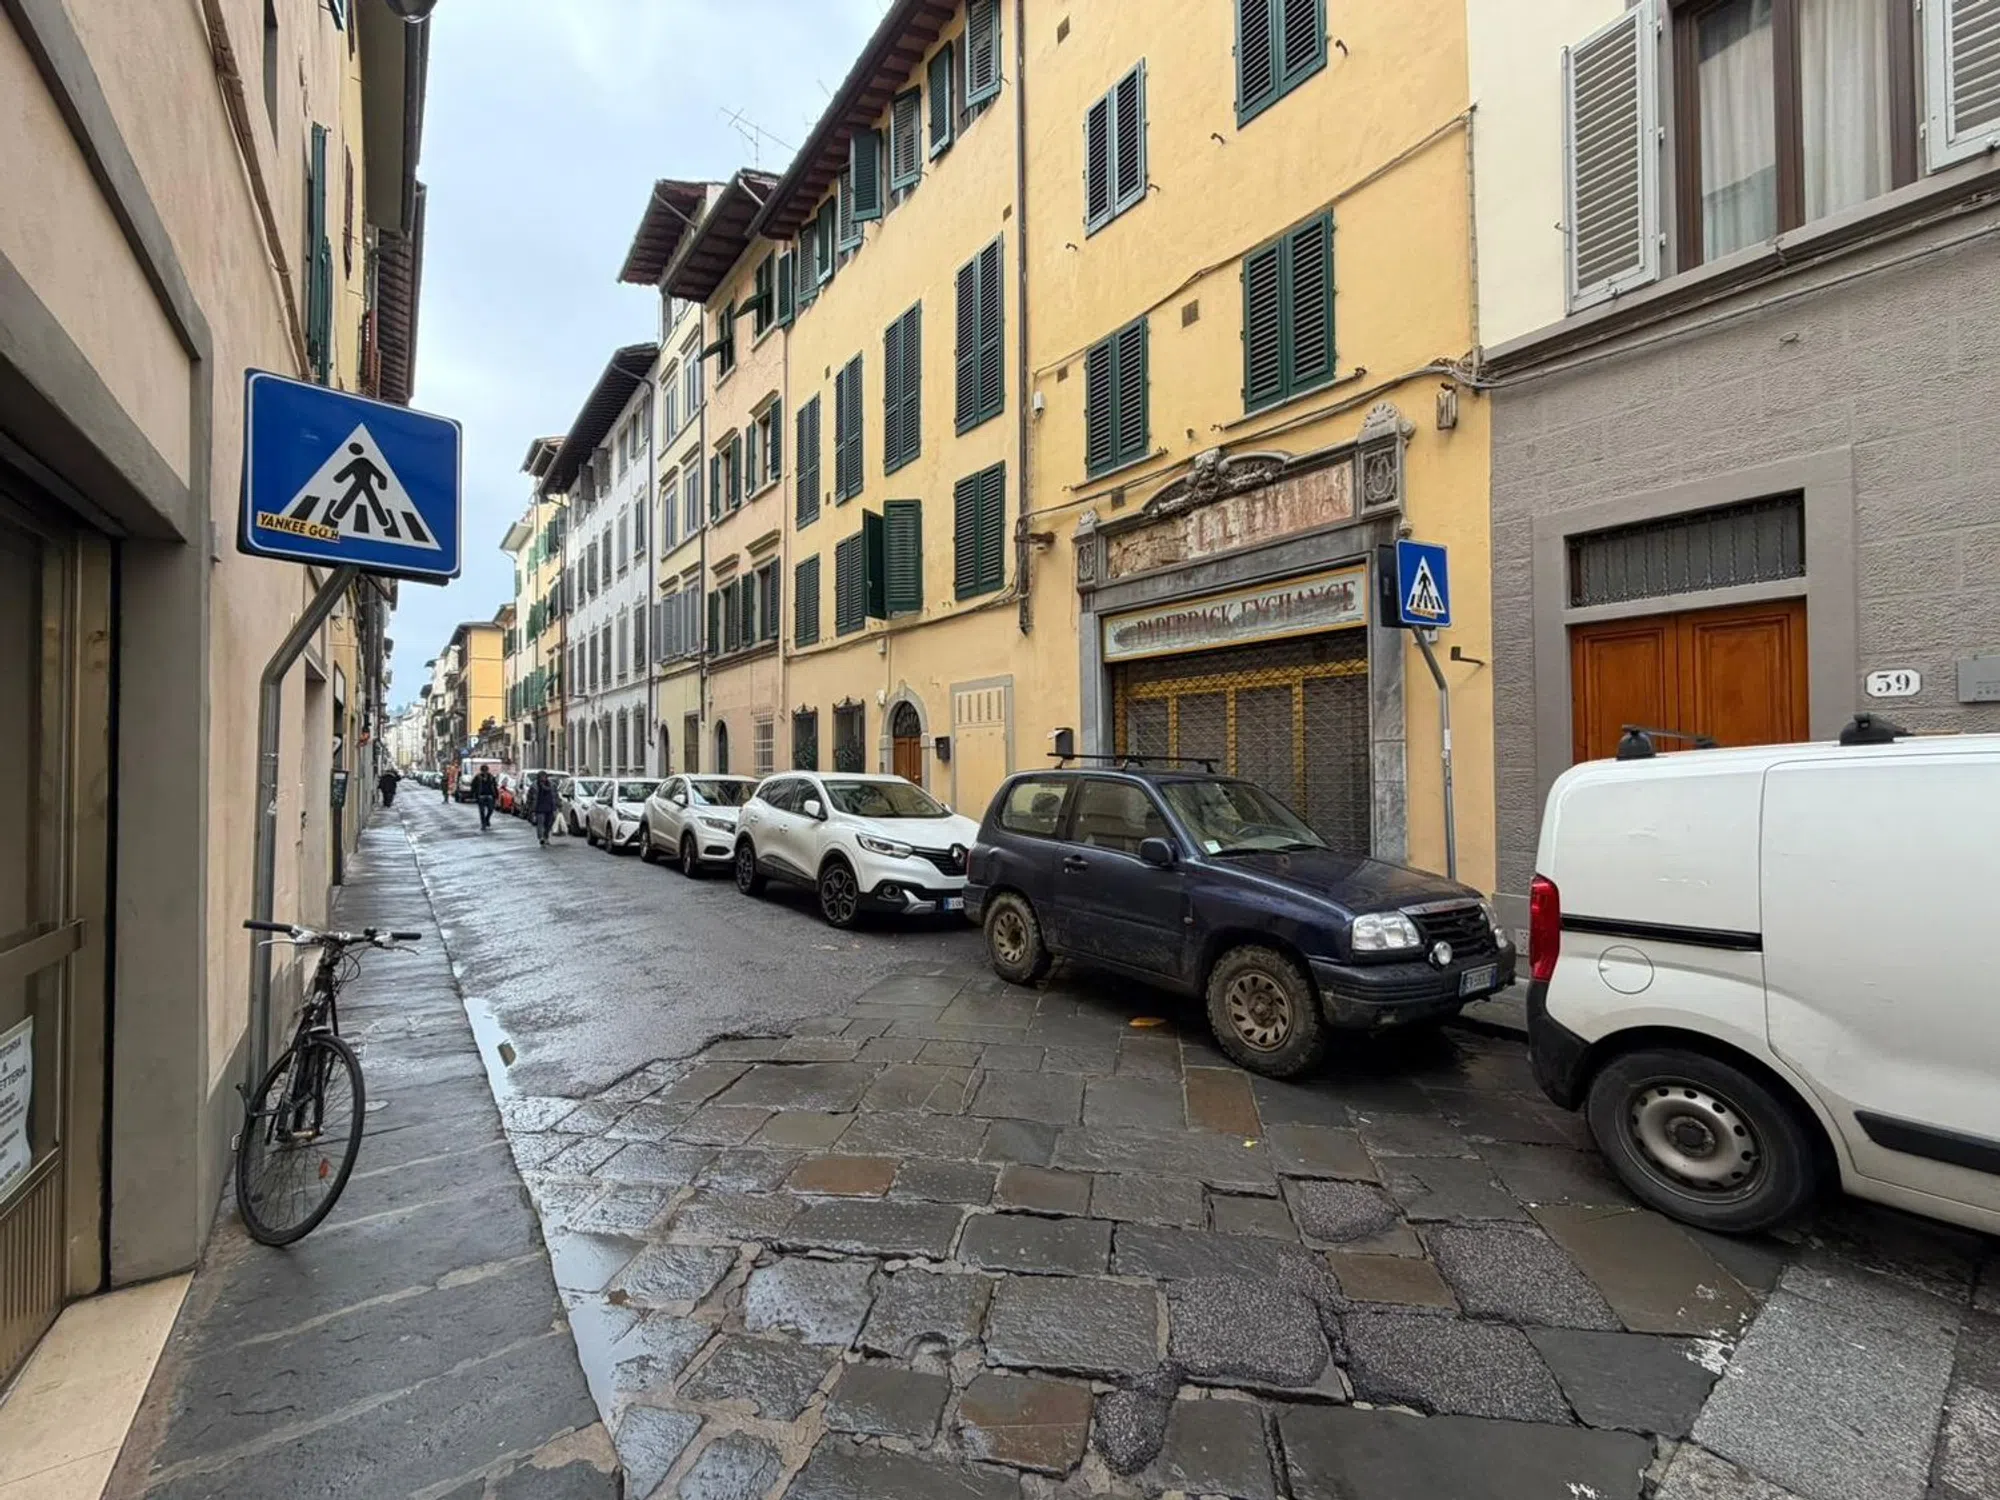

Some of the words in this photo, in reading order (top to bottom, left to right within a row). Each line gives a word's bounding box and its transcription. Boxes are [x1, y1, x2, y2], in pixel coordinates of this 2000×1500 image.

[261, 514, 305, 533] YANKEE
[309, 525, 327, 537] GO
[1877, 673, 1910, 692] 59
[471, 736, 479, 748] P
